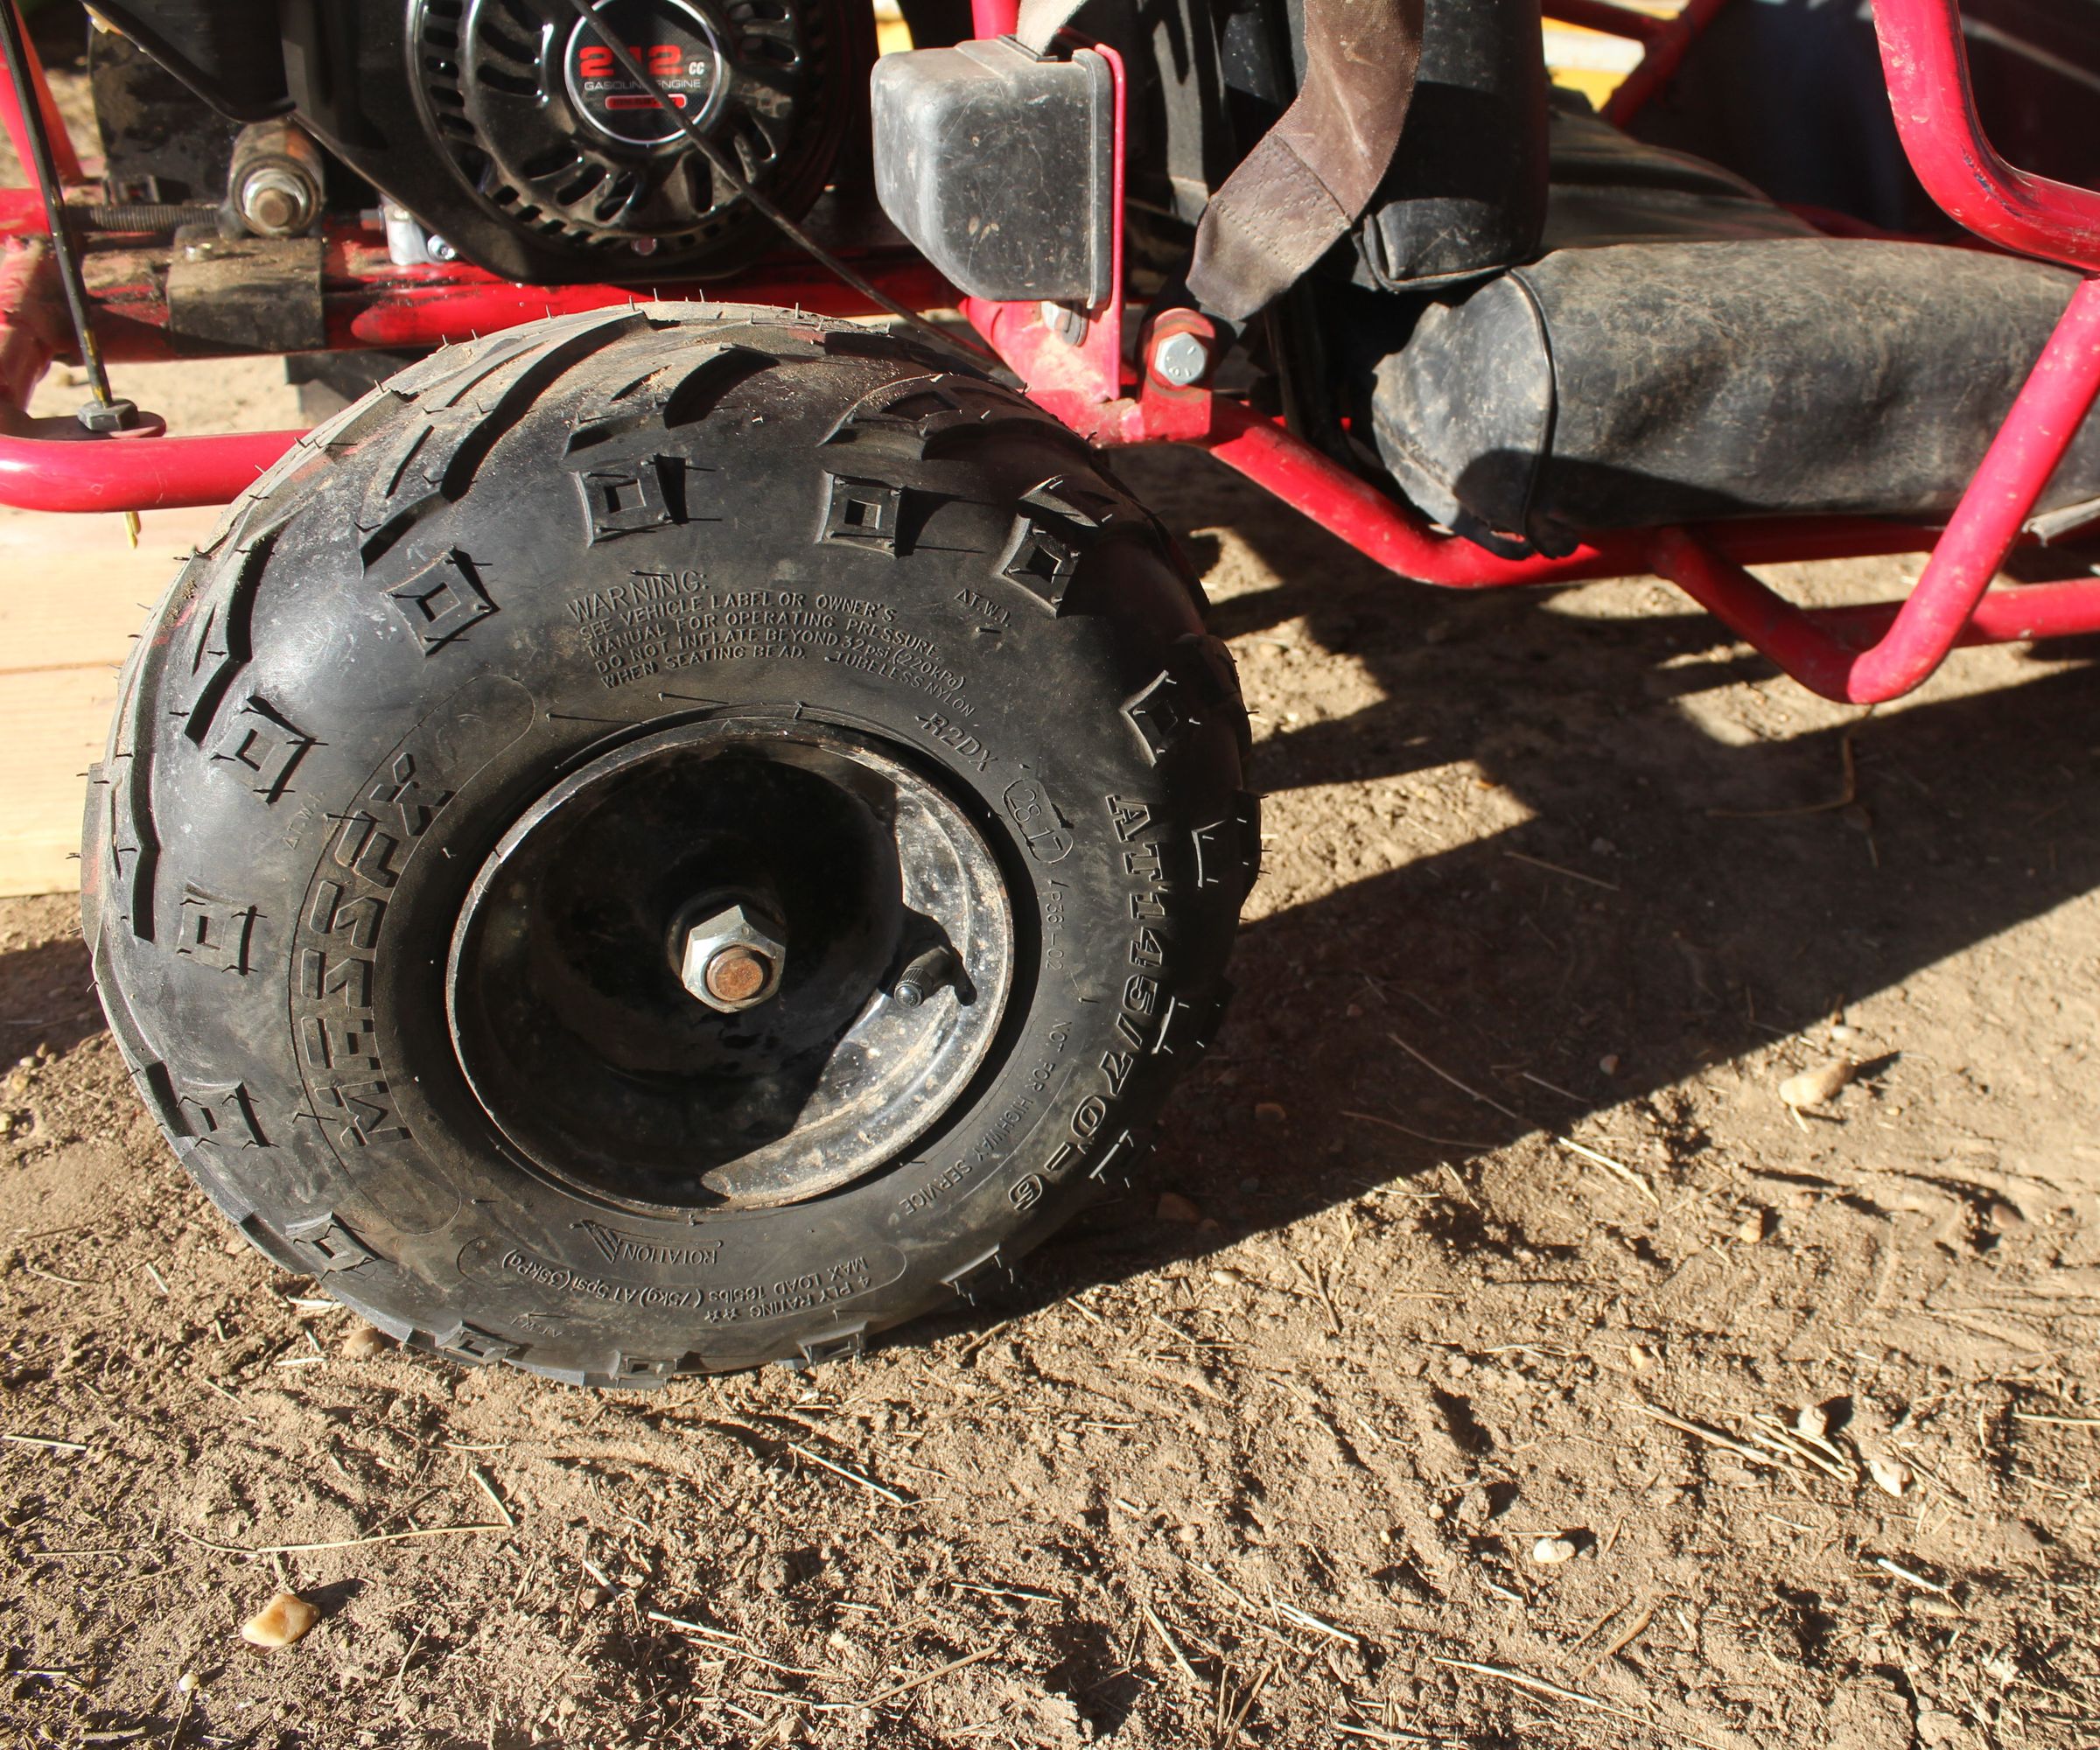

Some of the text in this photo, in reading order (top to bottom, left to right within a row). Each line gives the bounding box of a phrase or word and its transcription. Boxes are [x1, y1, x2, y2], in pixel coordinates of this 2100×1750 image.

[579, 45, 682, 77] 22
[584, 80, 649, 92] GASOLIN
[566, 570, 709, 623] WARNING:
[579, 592, 897, 640] SEE VEHICLE LABEL OR OWNER'S
[589, 623, 668, 658] MANUAL
[676, 614, 718, 633] FOR
[725, 611, 836, 629] OPERATING
[595, 654, 625, 674] DO
[630, 640, 669, 662] NOT
[679, 628, 759, 650] INFLATE
[766, 628, 840, 647] BEYOND
[892, 648, 967, 691] (220kPa)
[600, 661, 659, 690] WHEN
[664, 646, 746, 670] SEATING
[834, 651, 976, 718] TUBELESS NYLON
[1008, 794, 1166, 1211] AT145/70-6
[1025, 1060, 1056, 1093] FOR
[971, 1095, 1034, 1162] HIGHWAY
[898, 1159, 974, 1216] SERVICE
[623, 1242, 718, 1265] ROTATION
[613, 1286, 640, 1303] AT
[750, 1275, 872, 1319] 4 PLY RATING
[773, 1272, 823, 1295] LOAD
